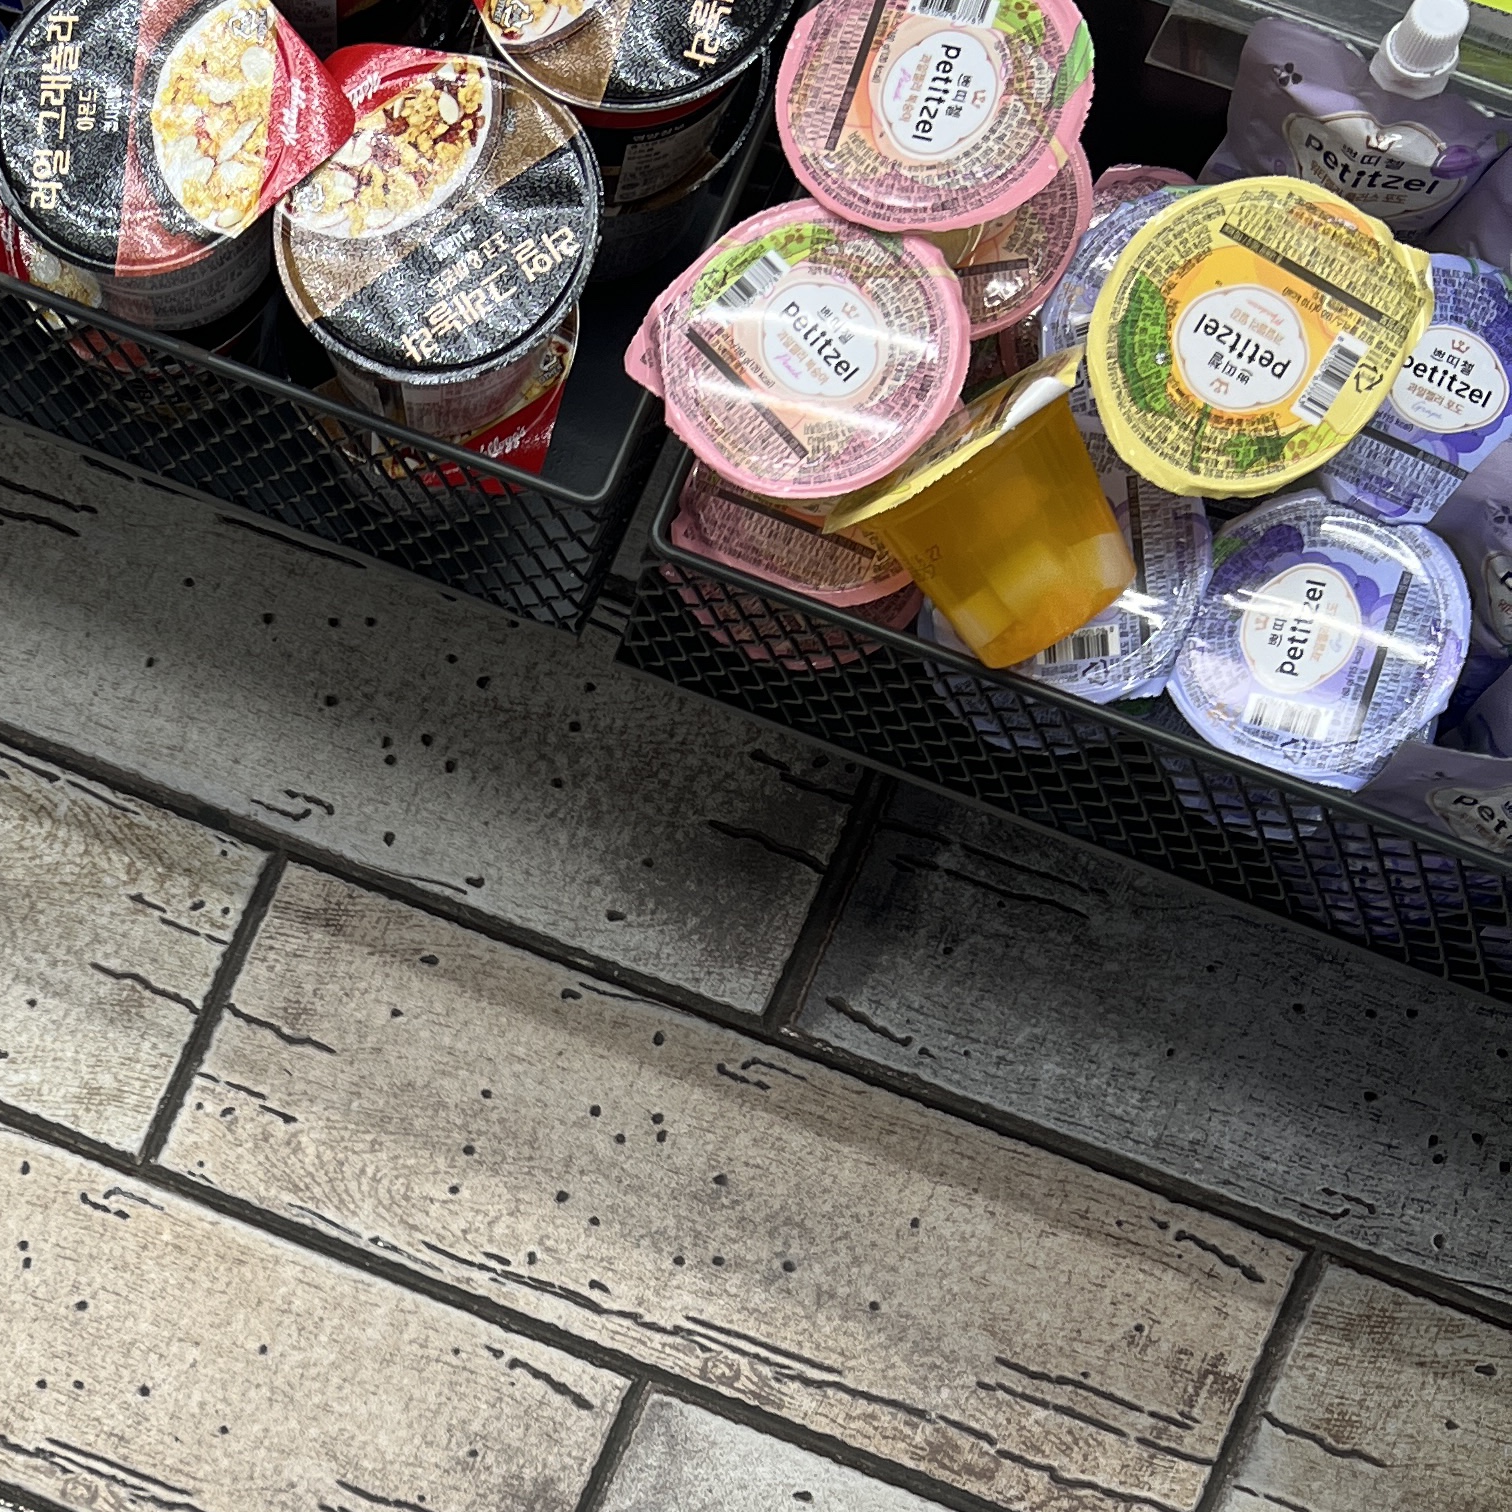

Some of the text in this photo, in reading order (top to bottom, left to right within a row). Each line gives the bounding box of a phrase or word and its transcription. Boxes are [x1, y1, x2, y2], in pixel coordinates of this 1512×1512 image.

[30, 11, 80, 211] 리얼 그래놀라
[76, 86, 99, 132] 아몬드
[912, 44, 962, 142] petitzel
[945, 73, 972, 118] 쁘띠첼
[1304, 134, 1440, 195] petitzel
[1341, 143, 1406, 170] 쁘띠첼
[479, 230, 510, 260] 초코
[401, 226, 581, 363] 리얼 그래놀라
[780, 301, 860, 382] petitzel
[1194, 313, 1292, 379] petitzel
[1430, 347, 1475, 376] 쁘띠첼
[1208, 351, 1253, 385] 쁘띠첼
[1408, 382, 1465, 415] 과일젤리 포도
[1268, 618, 1287, 647] 쁘띠
